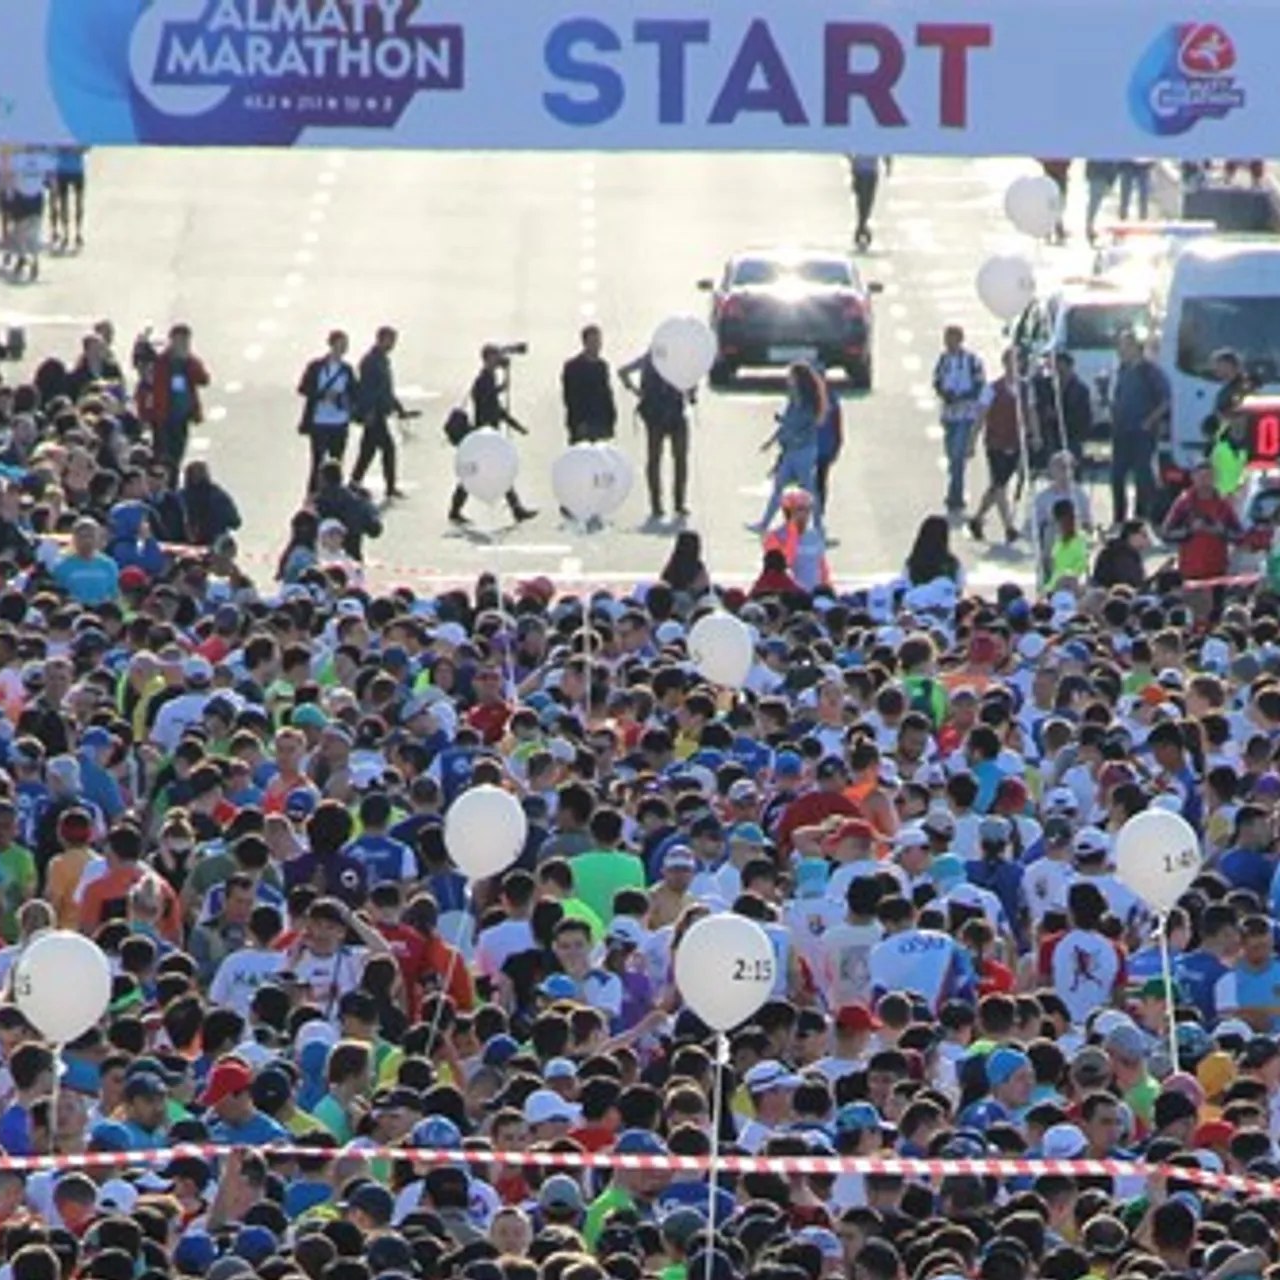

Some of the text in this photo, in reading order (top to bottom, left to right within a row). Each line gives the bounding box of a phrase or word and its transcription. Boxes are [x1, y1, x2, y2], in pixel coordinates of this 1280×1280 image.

[207, 0, 403, 32] ALMATY
[167, 36, 450, 78] MARATHON
[542, 17, 992, 128] START
[731, 956, 772, 981] 2:15
